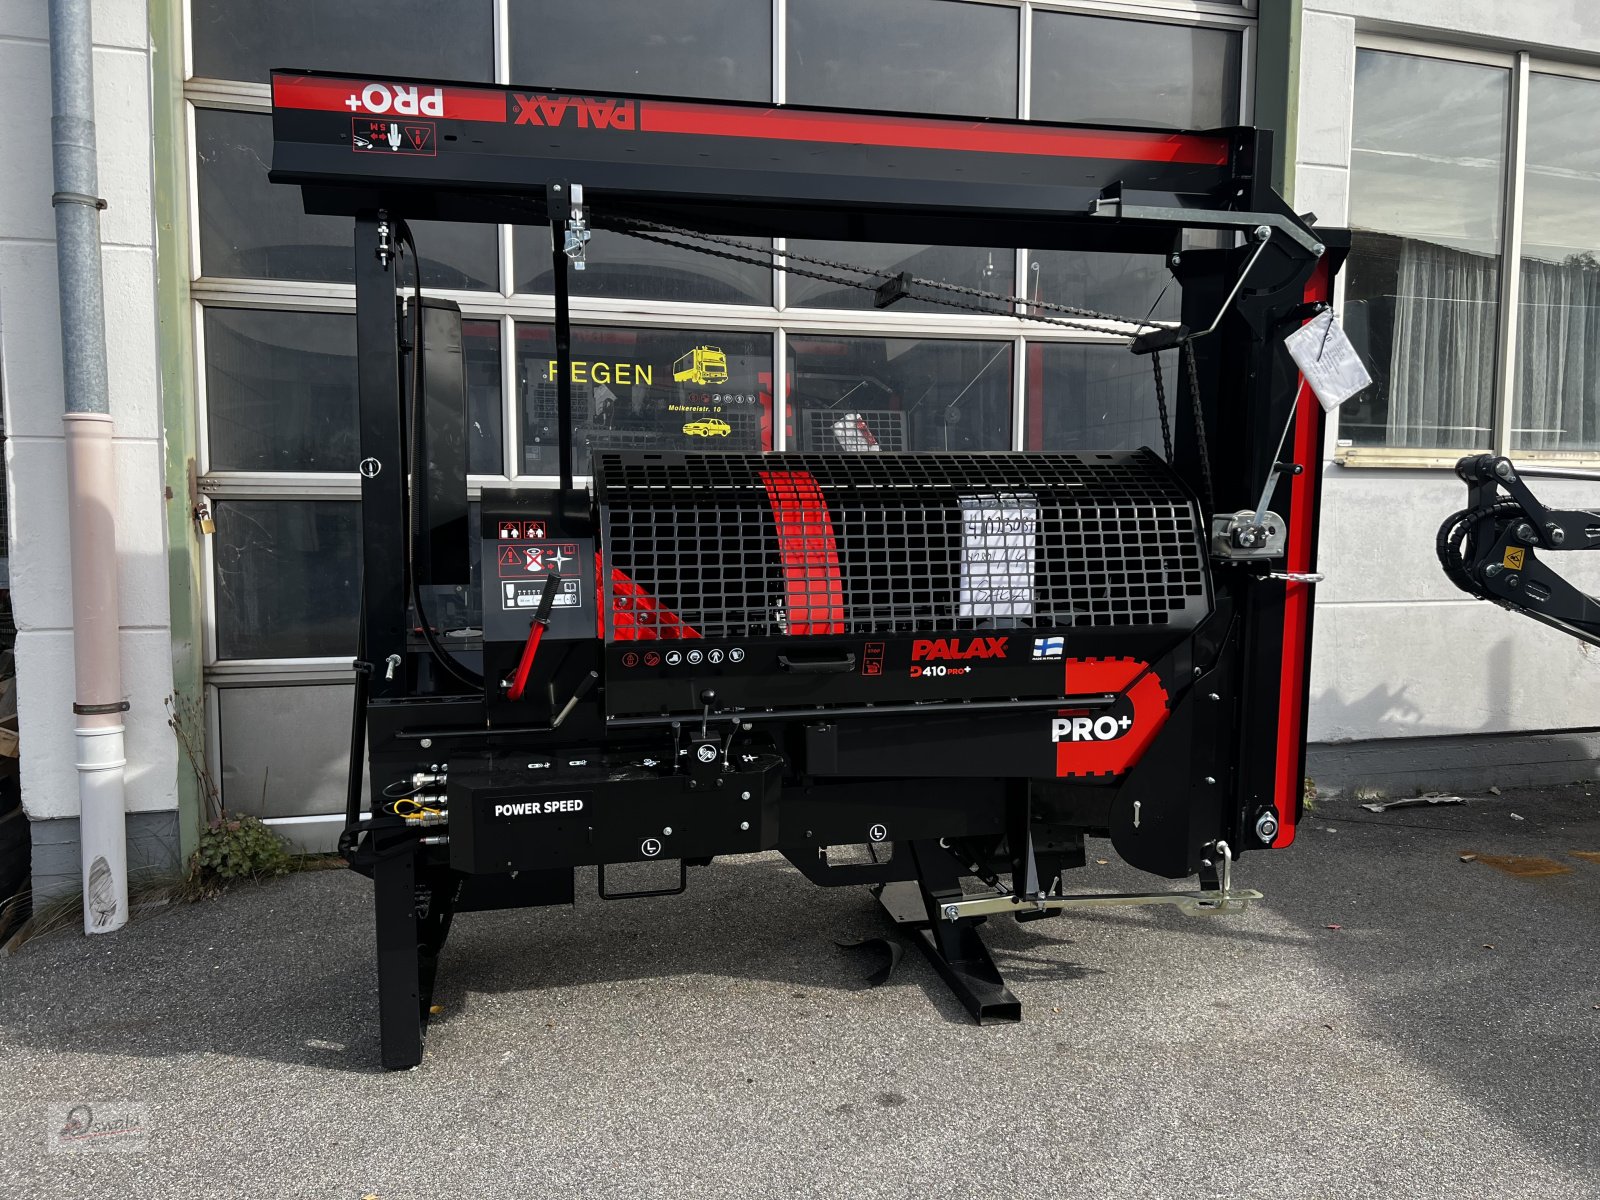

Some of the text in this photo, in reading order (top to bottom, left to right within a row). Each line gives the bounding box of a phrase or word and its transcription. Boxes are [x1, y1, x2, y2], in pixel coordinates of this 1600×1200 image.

[345, 83, 444, 117] PRO+
[668, 404, 711, 412] Molkereistr.
[1052, 715, 1132, 743] PRO+
[495, 799, 584, 816] POWER SPEED
